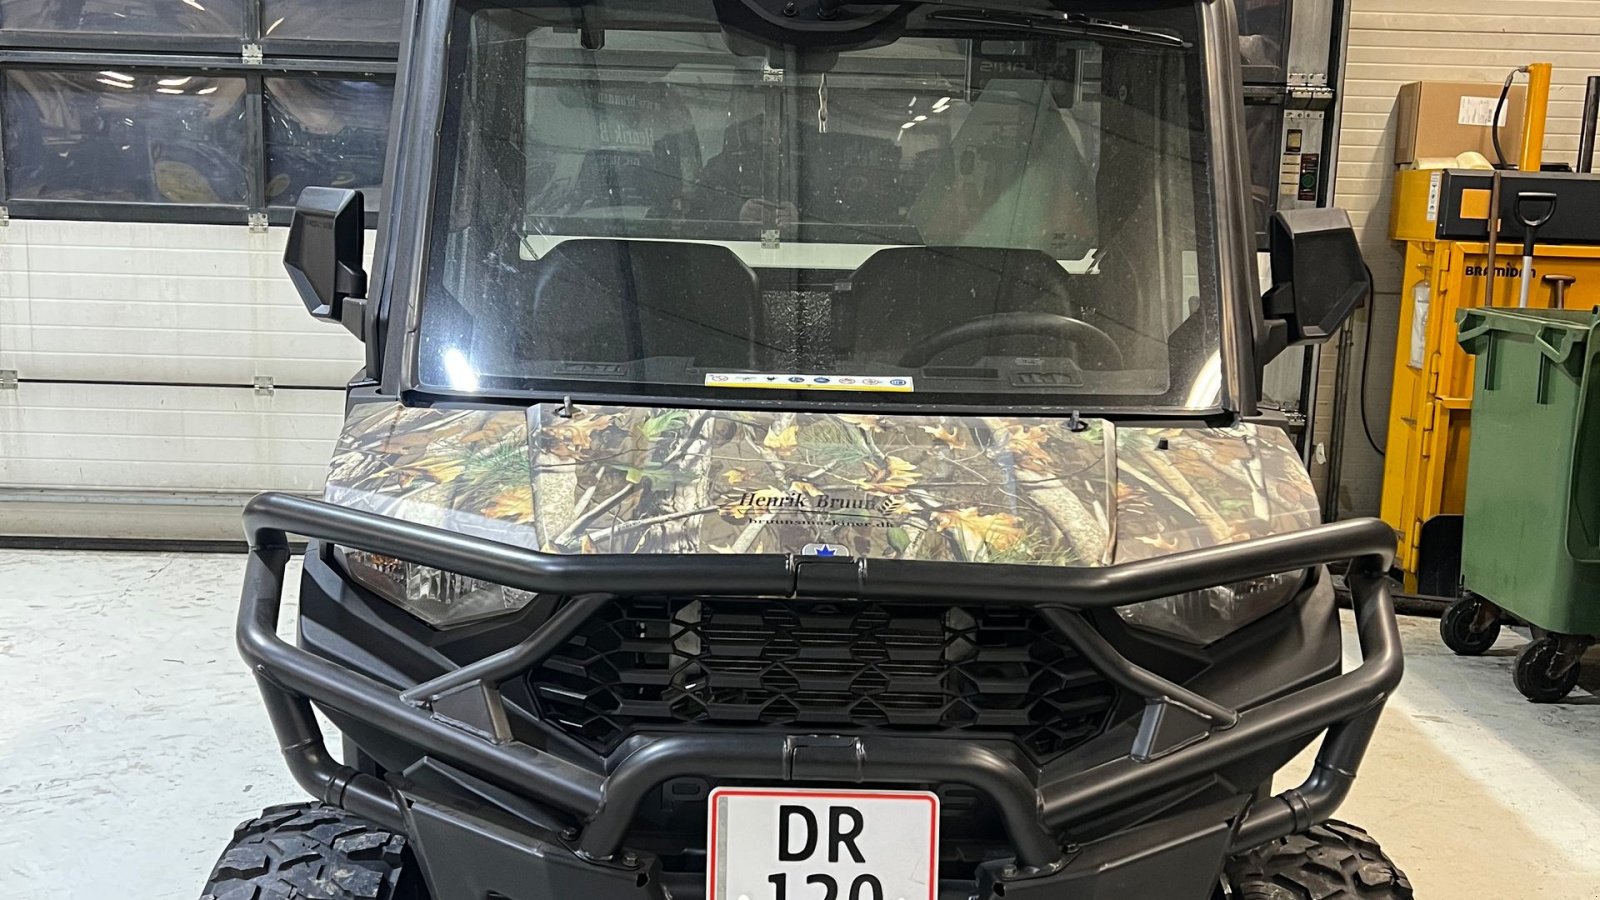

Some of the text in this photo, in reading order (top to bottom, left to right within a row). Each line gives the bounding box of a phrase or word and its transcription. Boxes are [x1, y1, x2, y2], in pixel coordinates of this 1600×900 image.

[739, 493, 877, 510] Henrik Bruun
[749, 518, 895, 529] bruunsmaskiner.dk
[778, 805, 865, 863] DR
